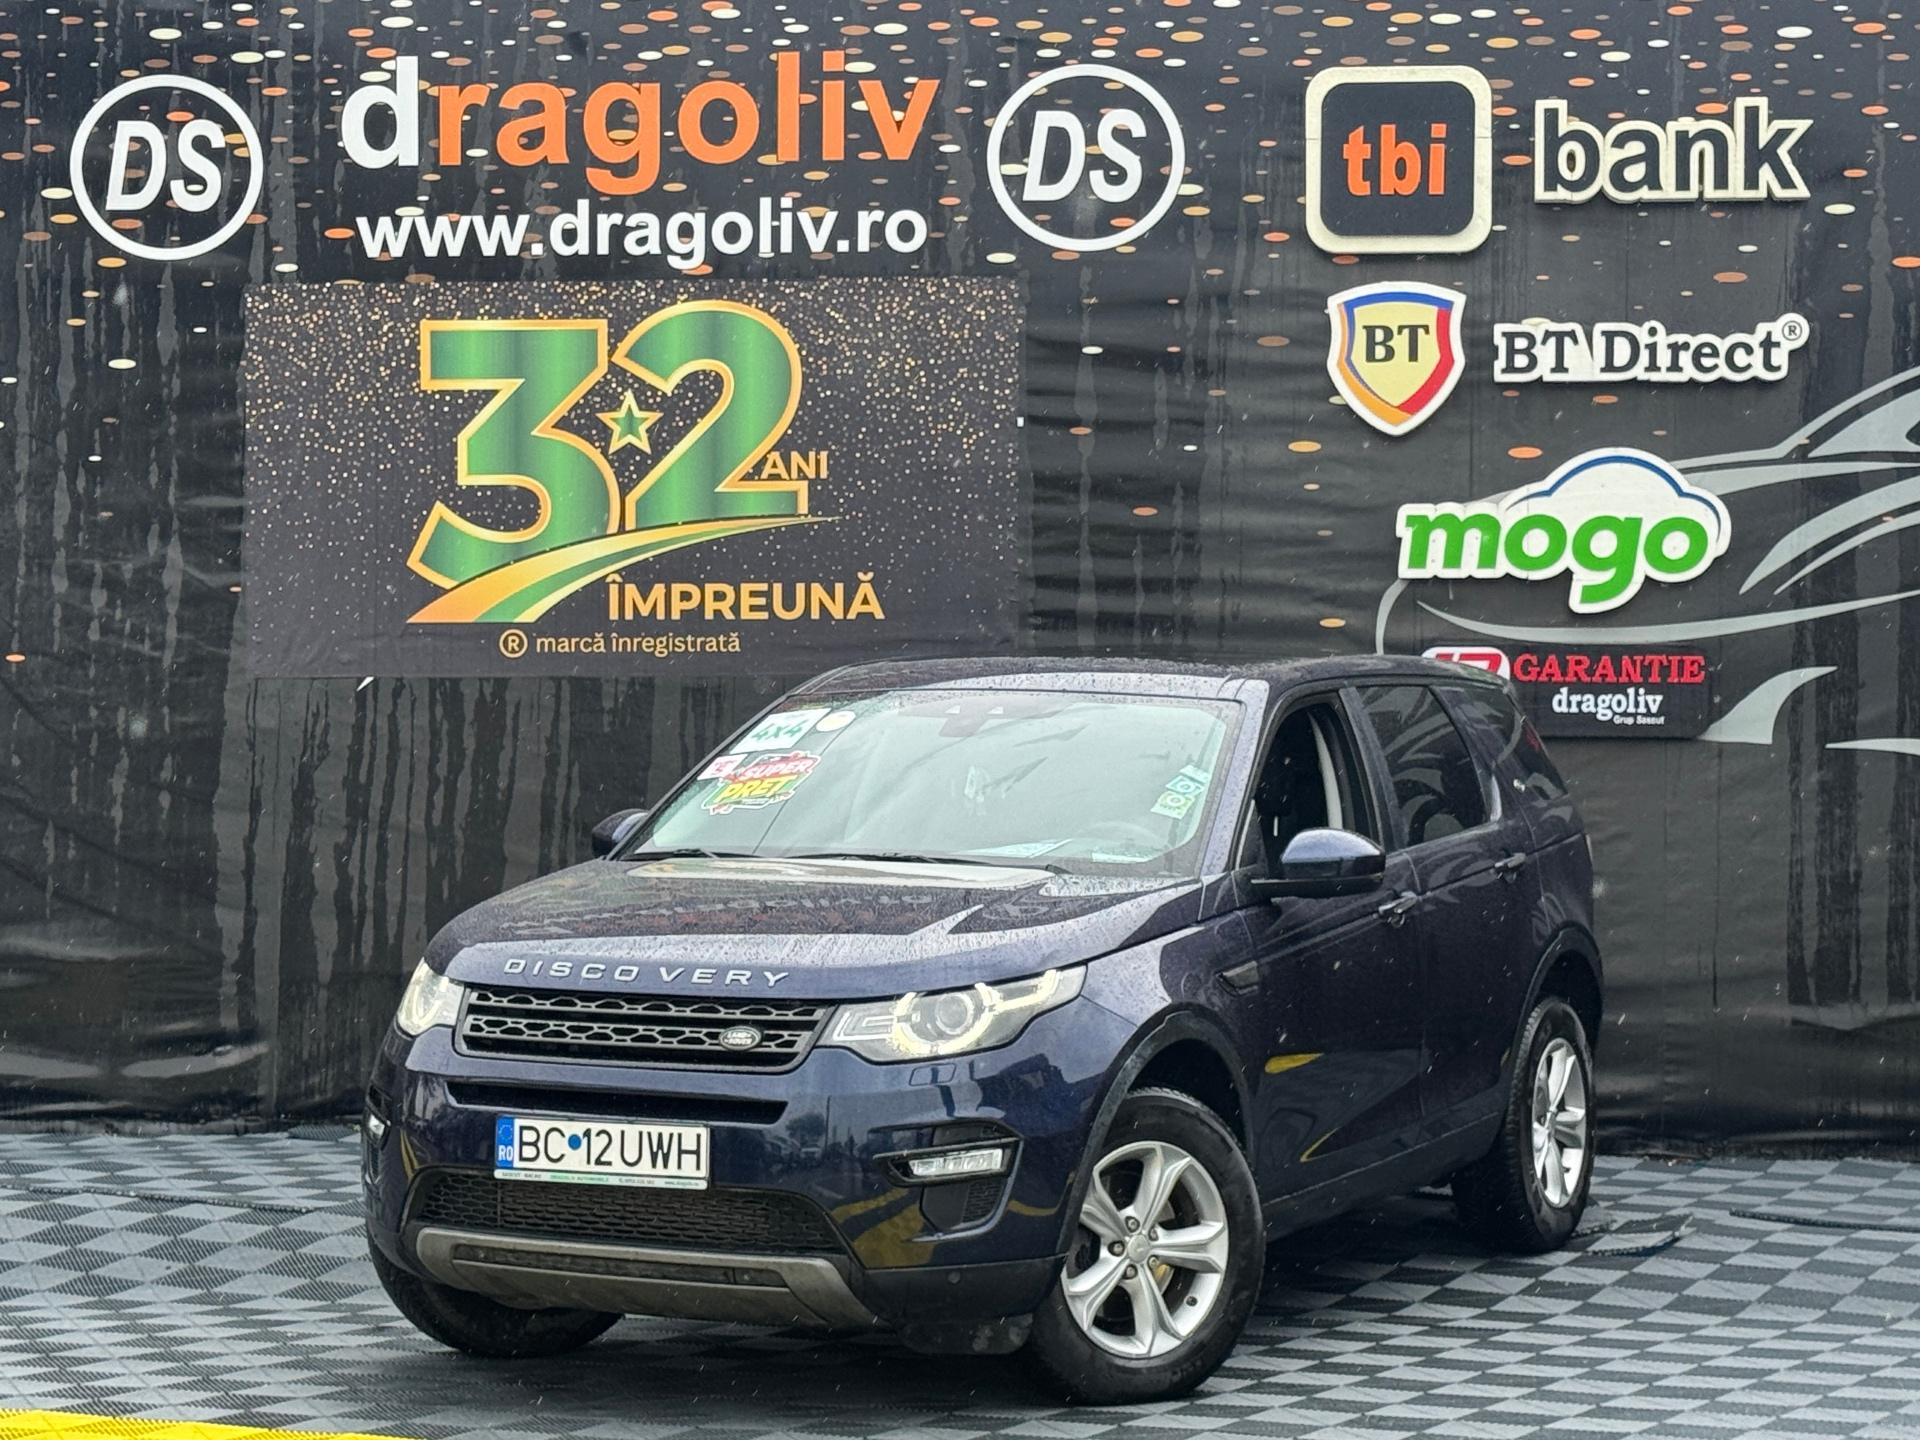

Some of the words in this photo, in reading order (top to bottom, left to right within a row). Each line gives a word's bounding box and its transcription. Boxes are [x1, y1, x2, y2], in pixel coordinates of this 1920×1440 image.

[340, 50, 940, 195] dragoliv
[105, 118, 226, 213] DS
[1022, 108, 1147, 203] DS
[1343, 122, 1448, 196] tbi
[1540, 101, 1807, 197] bank
[356, 197, 928, 271] www.dragoliv.ro
[1363, 324, 1430, 364] BT
[1500, 329, 1579, 374] BT
[407, 299, 808, 589] 32
[760, 450, 829, 480] ANI
[1405, 512, 1709, 604] mogo
[607, 571, 886, 620] ÎMPREUNĂ
[536, 632, 607, 653] marcă
[611, 631, 741, 658] înregistrată
[1513, 653, 1706, 684] GARANTIE
[1552, 686, 1664, 721] dragoliv
[499, 1145, 514, 1162] RO
